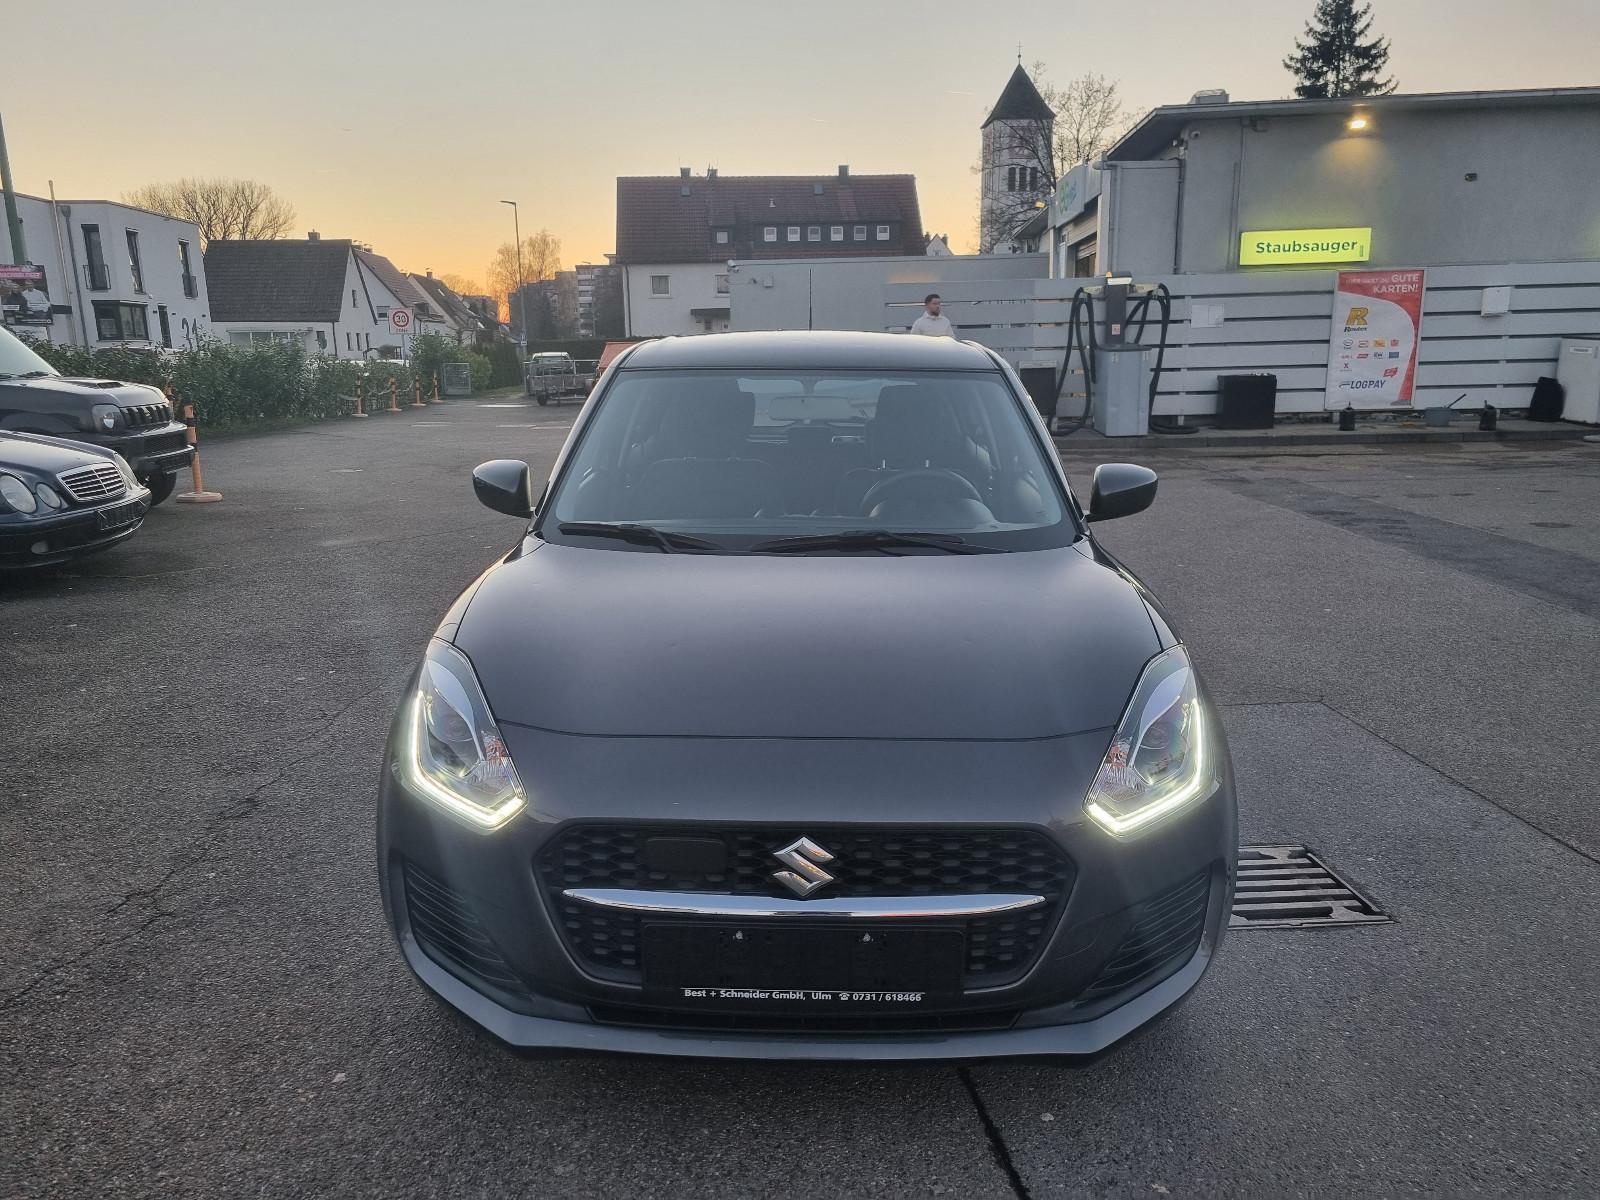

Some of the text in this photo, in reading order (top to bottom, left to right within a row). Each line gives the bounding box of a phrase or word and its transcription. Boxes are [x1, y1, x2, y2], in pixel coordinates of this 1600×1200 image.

[1256, 241, 1358, 254] Staubsauger
[1391, 273, 1420, 283] GUTE
[1373, 284, 1418, 293] KARTEN!
[395, 314, 407, 324] 30
[1350, 380, 1386, 389] LOGPAY
[684, 989, 706, 997] Best
[709, 989, 717, 998] +
[719, 989, 770, 999] Schneider
[772, 991, 805, 1001] GmbH,
[811, 991, 832, 1000] Ulm
